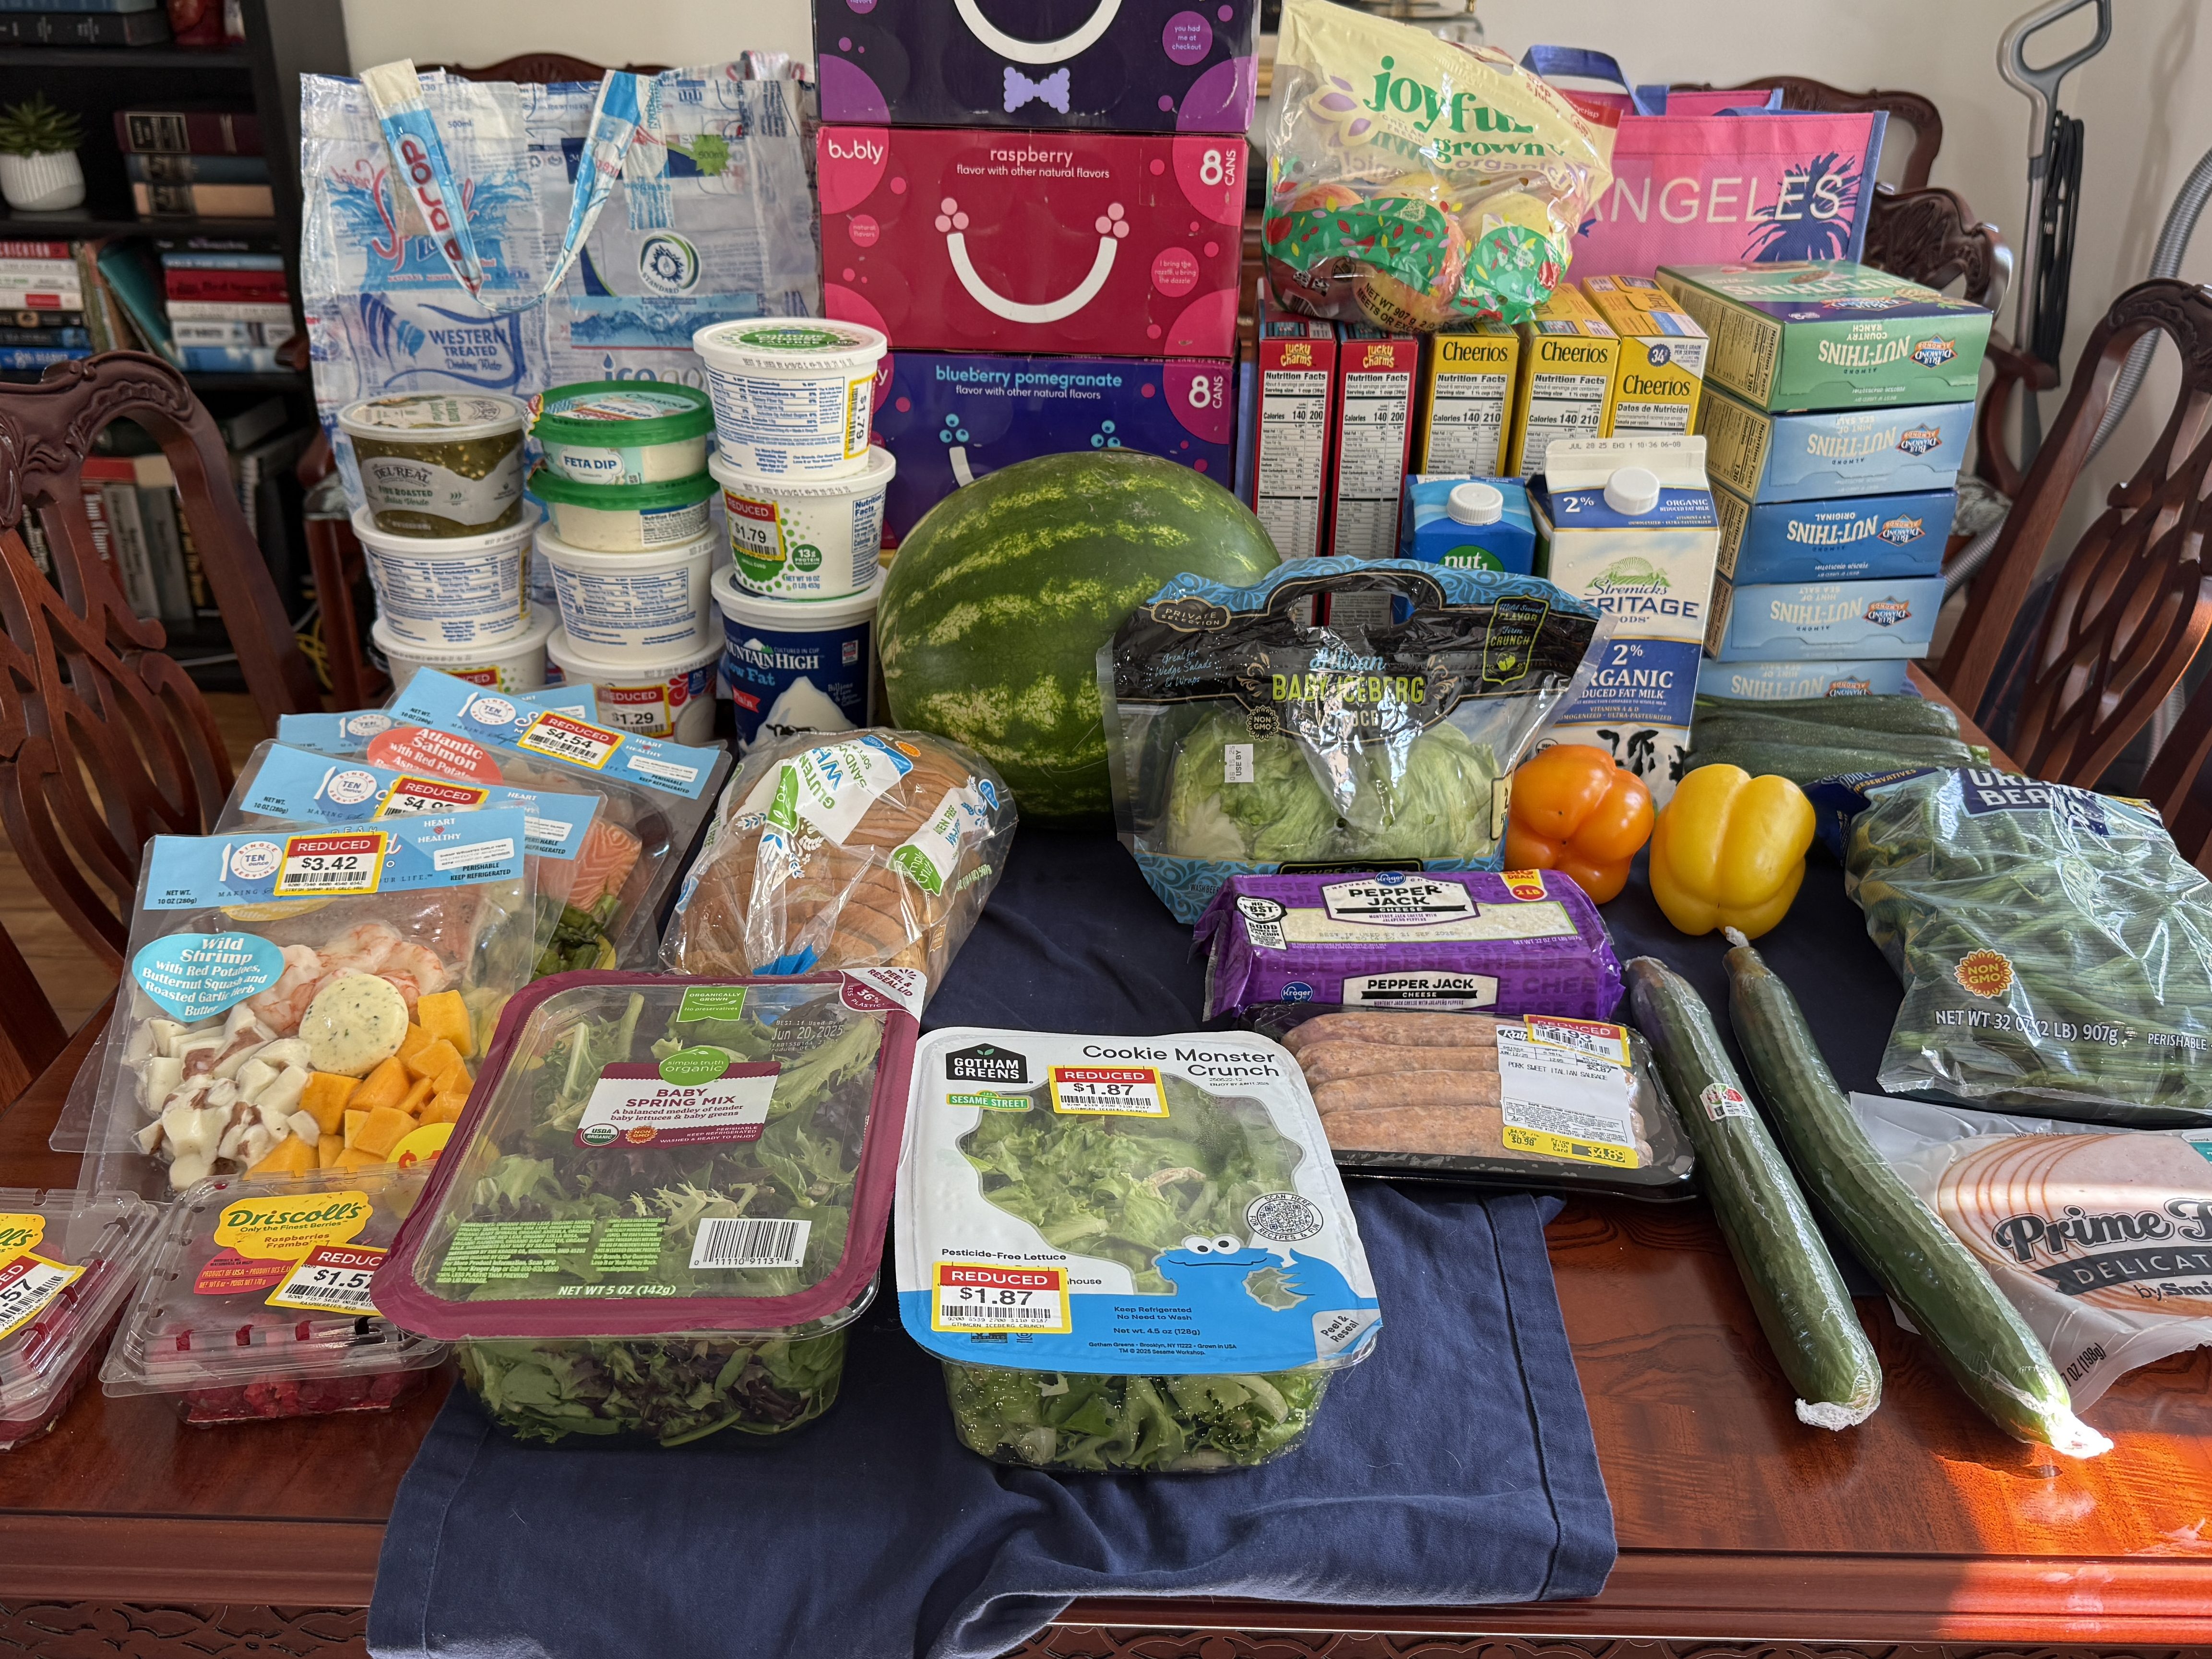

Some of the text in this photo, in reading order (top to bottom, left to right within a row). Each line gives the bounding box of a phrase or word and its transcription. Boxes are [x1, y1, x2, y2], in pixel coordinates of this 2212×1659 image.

[989, 147, 1073, 165] raspberry
[956, 164, 1110, 178] flavor with other natural flavors
[1199, 149, 1223, 186] 8
[1224, 149, 1237, 186] CANS
[429, 329, 508, 345] WESTERN
[1846, 332, 1888, 341] COUNTRY
[443, 346, 498, 357] TREATED
[1442, 341, 1508, 363] Cheerios
[1541, 341, 1608, 363] Cheerios
[1818, 335, 1911, 366] NUT-THINS
[936, 366, 1122, 388] blueberry pomegranate
[1386, 374, 1408, 382] Facts
[1437, 375, 1506, 383] Nutrition Facts
[1535, 375, 1605, 385] Nutrition Facts
[1212, 375, 1224, 409] CANS
[1623, 374, 1690, 396] Cheerios
[955, 385, 1101, 400] flavor with other natural flavors
[1189, 376, 1212, 409] 8
[1807, 425, 1896, 458] NUT-THINS
[563, 456, 618, 470] FETA DIP
[1563, 496, 1595, 513] 2%
[1666, 498, 1708, 507] ORGANIC
[855, 505, 874, 516] Facts
[1815, 512, 1855, 521] ORIGINAL
[735, 522, 767, 544] $1.79
[1786, 515, 1879, 545] NUT-THINS
[1584, 579, 1668, 596] Stremicks
[1165, 607, 1217, 620] PRIVATE
[1770, 596, 1863, 624] NUT-THINS
[1160, 615, 1222, 627] SELECTION
[1490, 636, 1530, 646] CRUNCH
[1611, 644, 1643, 666] 2%
[1639, 689, 1665, 699] MILK
[1731, 675, 1825, 699] NUT-THINS
[548, 716, 610, 743] REDUCED
[635, 737, 664, 749] HEART
[625, 744, 663, 758] HEALTHY
[1236, 750, 1241, 760] BY
[405, 782, 472, 802] REDUCED
[424, 818, 456, 828] HEART
[418, 832, 462, 843] HEALTHY
[297, 840, 371, 852] REDUCED
[245, 854, 265, 863] TEN
[301, 856, 358, 872] $3.42
[463, 863, 500, 872] PERISHABLE
[467, 869, 511, 880] REFRIGERATED
[1349, 885, 1442, 898] PEPPER
[1368, 896, 1430, 907] JACK
[202, 937, 244, 952] Wild
[180, 948, 253, 967] Shrimp
[156, 961, 261, 977] with Red Potatoes,
[1967, 964, 1999, 975] NON
[1367, 978, 1474, 990] PEPPER JACK
[1968, 973, 2001, 984] GMO
[689, 991, 741, 999] ORGANICALLY
[1537, 1024, 1593, 1043] $2.93
[1935, 1010, 1964, 1025] NET
[1967, 1011, 1990, 1027] WT
[1994, 1013, 2011, 1031] 32
[2054, 1021, 2078, 1041] LB)
[2082, 1023, 2119, 1045] 907g
[2148, 1032, 2207, 1050] PERISHABLE
[1082, 1044, 1276, 1063] Cookie Monster
[954, 1057, 1020, 1069] GOTHAM
[954, 1066, 1021, 1079] GREENS
[1064, 1071, 1145, 1080] REDUCED
[1187, 1064, 1280, 1077] Crunch
[1508, 1061, 1608, 1081] PORK SWEET ITALIAN SAUSAGE
[656, 1088, 708, 1097] BABY
[1072, 1083, 1135, 1096] $1.87
[625, 1096, 737, 1107] SPRING MIX
[951, 1094, 1027, 1107] SESAME STREET
[1511, 1136, 1534, 1146] $0.98
[1587, 1147, 1626, 1162] $4.89
[1264, 1194, 1312, 1208] SCAN HERE
[227, 1202, 363, 1228] Driscoll's
[275, 1222, 306, 1231] Finest
[308, 1220, 343, 1228] Berries
[1249, 1215, 1259, 1227] FOR
[1259, 1226, 1296, 1240] RECIPES
[1309, 1224, 1320, 1234] FUN
[264, 1232, 330, 1243] Raspberries
[1992, 1204, 2175, 1264] Prime
[941, 1248, 1067, 1261] Pesticide-Free Lettuce
[951, 1270, 1048, 1285] REDUCED
[557, 1285, 676, 1297] NET WT 5 OZ (142g)
[959, 1286, 1034, 1306] $1.87
[2136, 1283, 2162, 1301] by
[1114, 1305, 1192, 1315] Keep Refrigerated
[1174, 1327, 1201, 1336] (128g)
[1330, 1320, 1359, 1343] Reseal
[2070, 1363, 2084, 1381] OZ
[2081, 1342, 2107, 1374] (198g)
